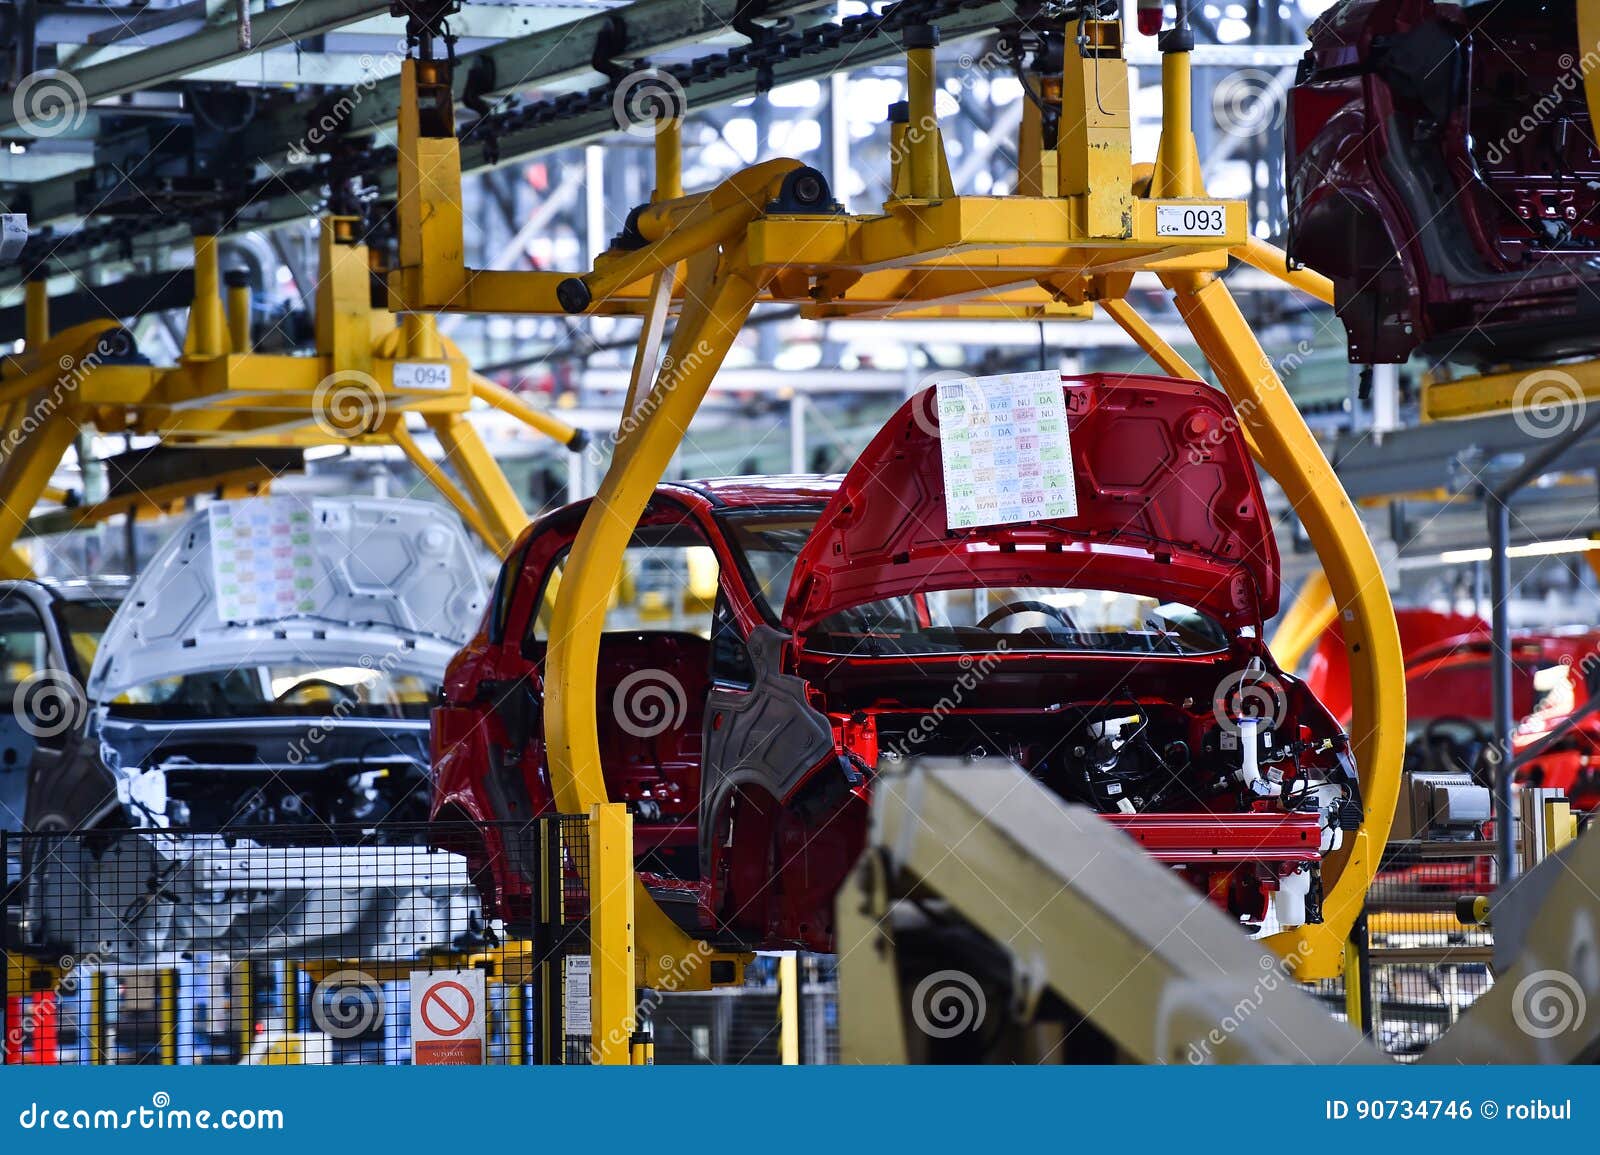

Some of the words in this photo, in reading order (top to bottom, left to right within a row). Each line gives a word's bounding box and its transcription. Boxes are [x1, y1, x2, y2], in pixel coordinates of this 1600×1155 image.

[1184, 210, 1222, 230] 093
[415, 367, 446, 383] 094
[1018, 399, 1030, 407] NU
[998, 428, 1011, 437] DA
